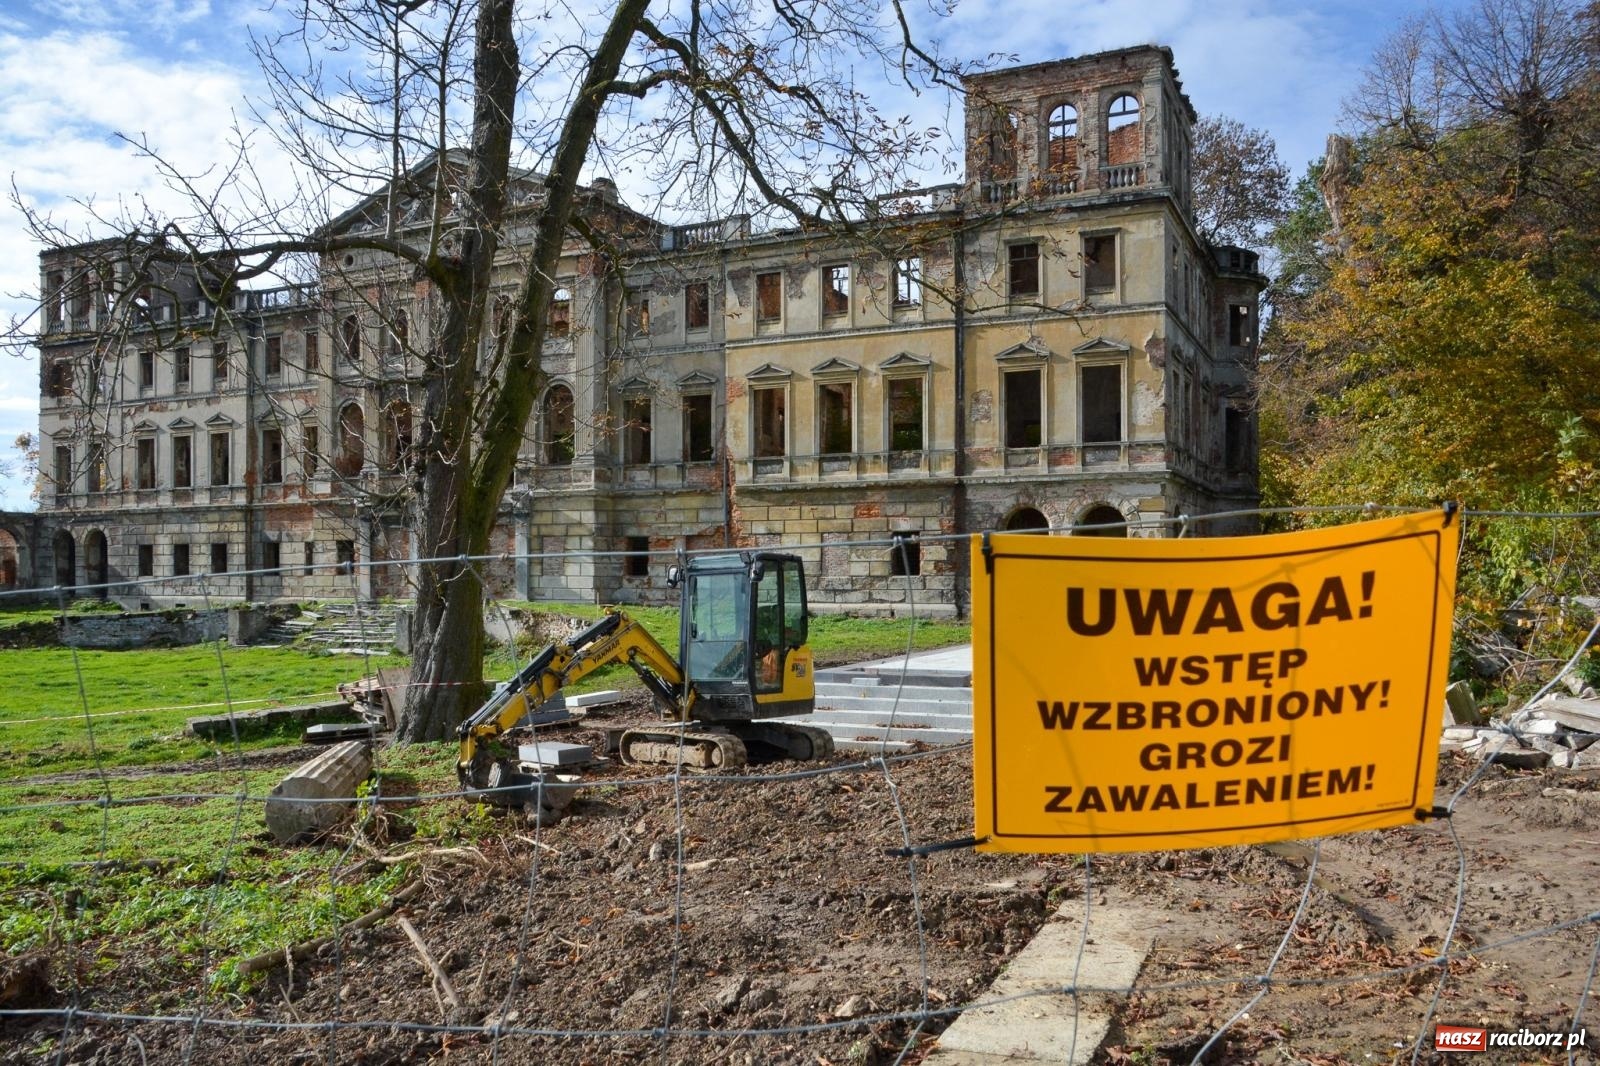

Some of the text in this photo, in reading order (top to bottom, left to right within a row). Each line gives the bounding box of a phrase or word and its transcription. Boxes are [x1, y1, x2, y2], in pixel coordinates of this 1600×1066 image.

[1066, 571, 1375, 637] UWAGA!
[1133, 647, 1308, 689] WSTĘP
[1036, 680, 1391, 731] WZBRONIONY!
[1139, 734, 1291, 772] GROZI
[1044, 764, 1376, 813] ZAWALENIEM!
